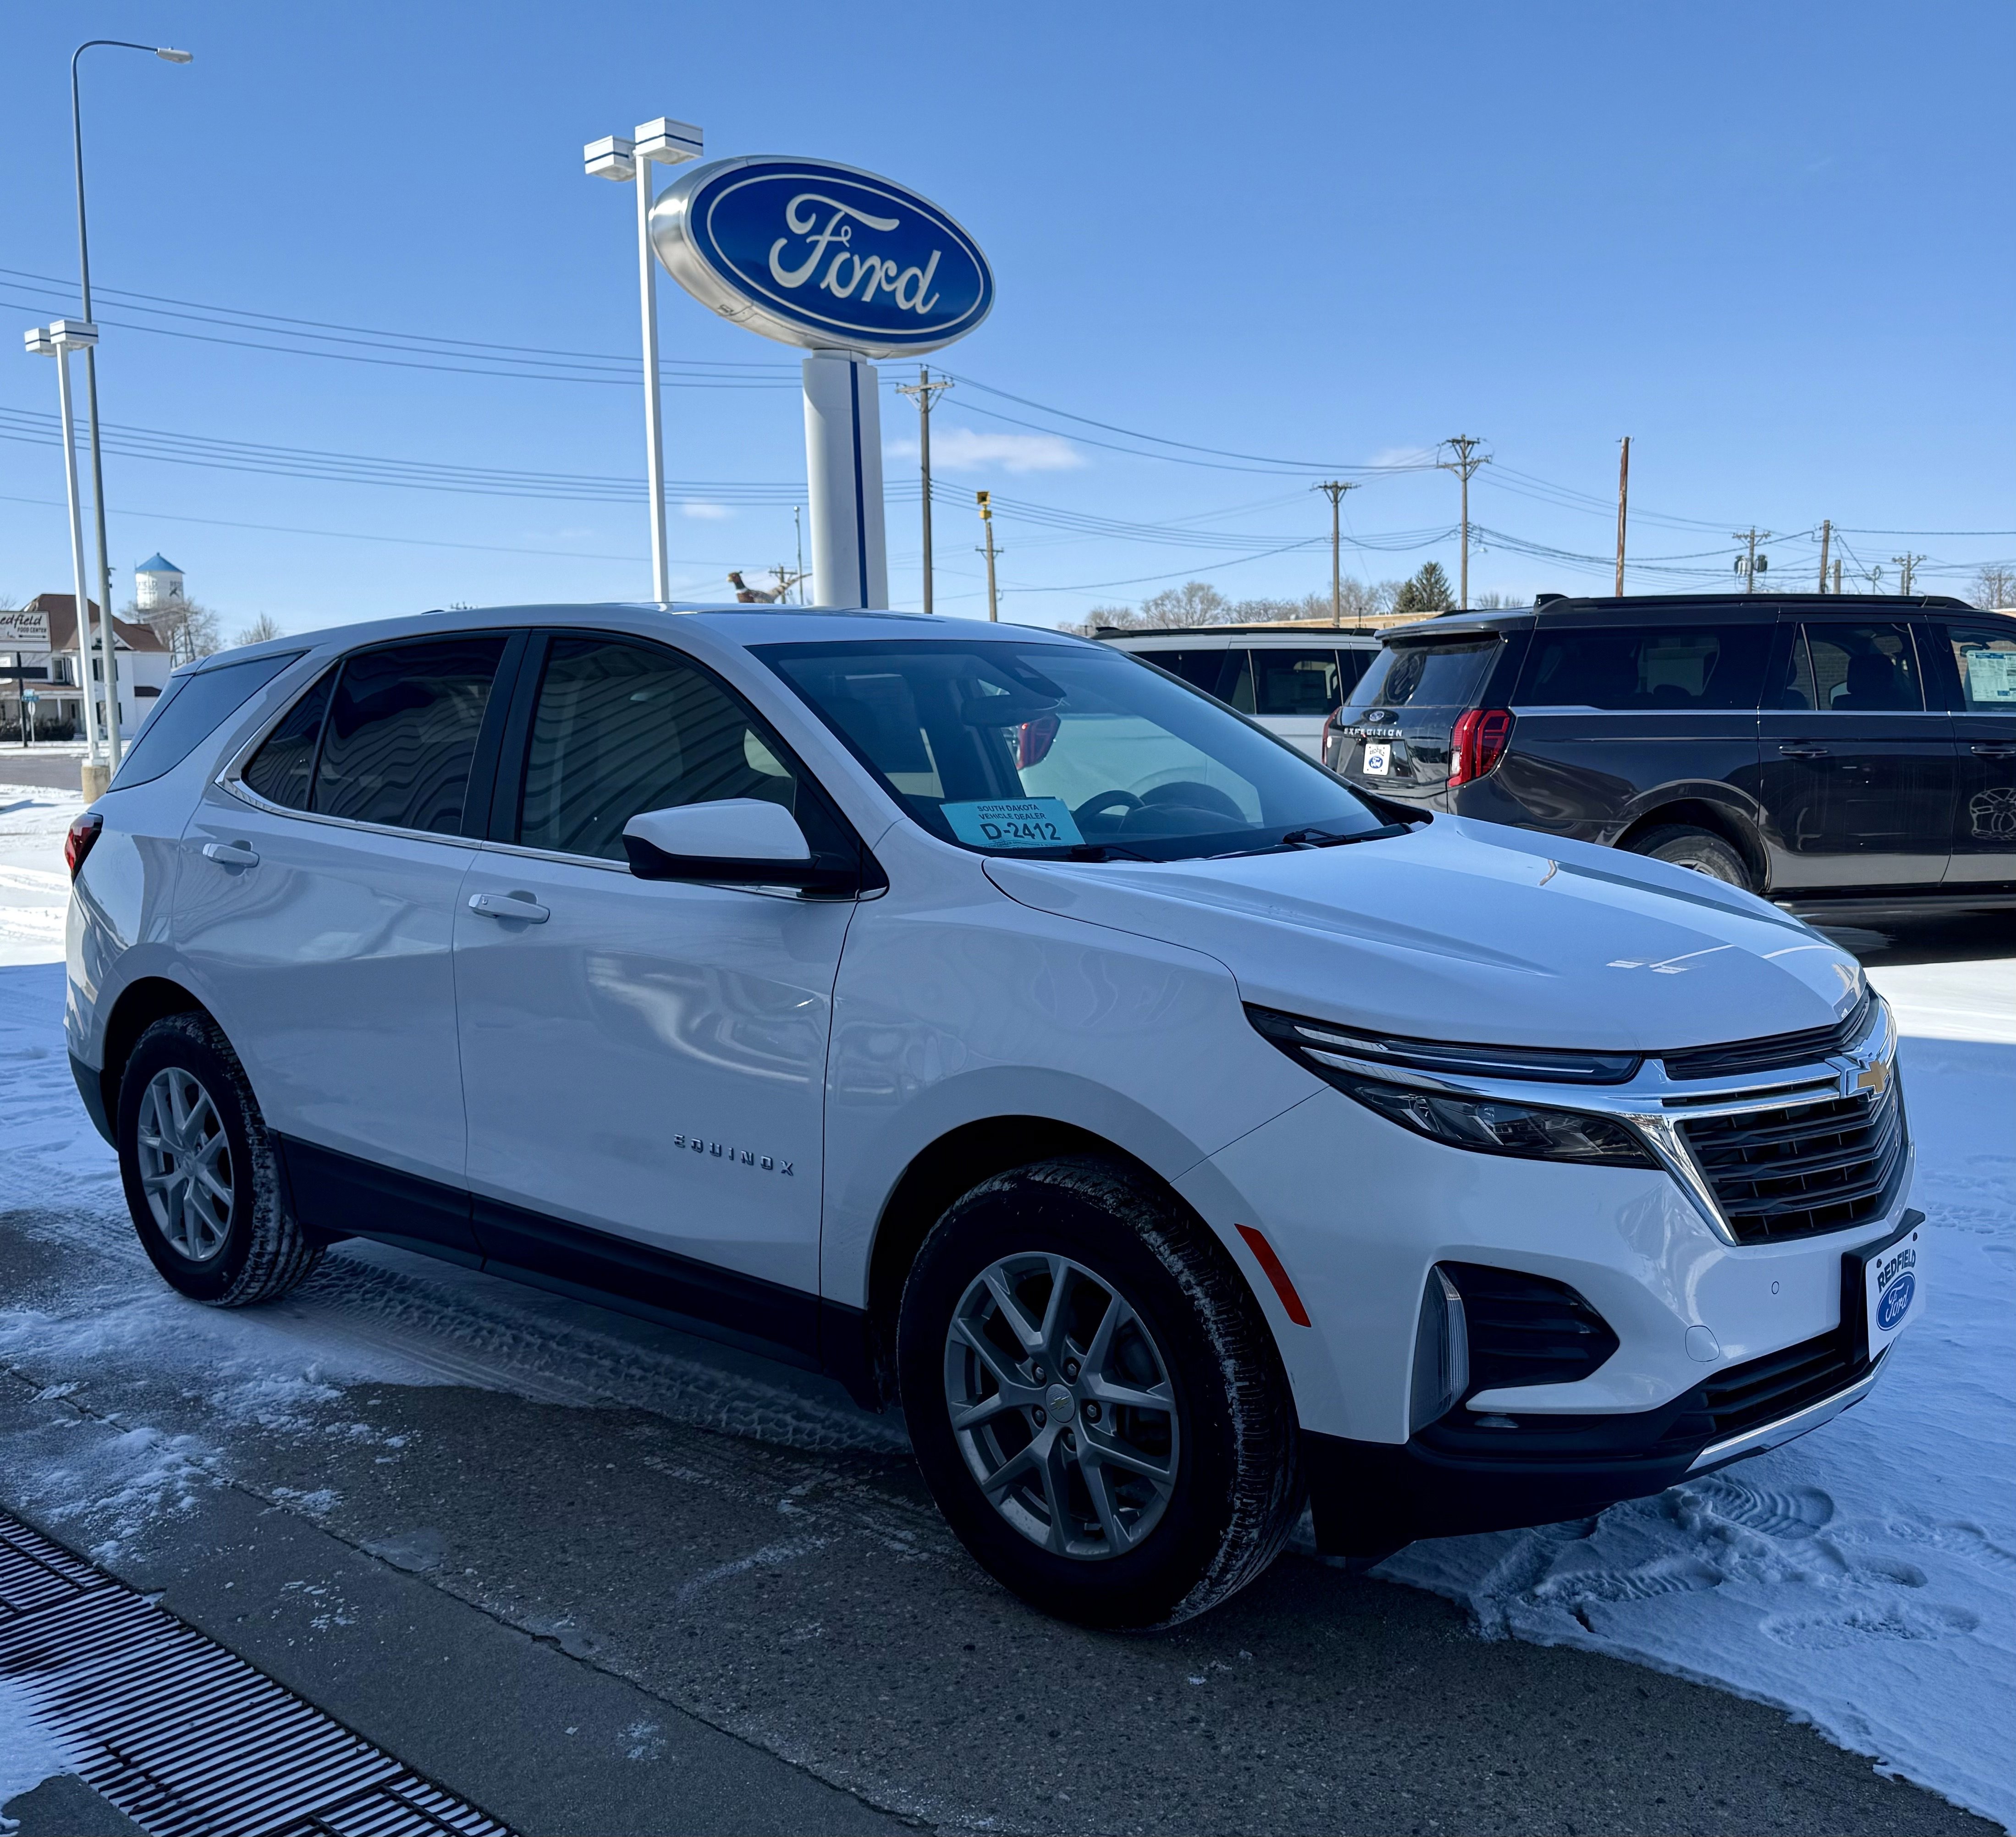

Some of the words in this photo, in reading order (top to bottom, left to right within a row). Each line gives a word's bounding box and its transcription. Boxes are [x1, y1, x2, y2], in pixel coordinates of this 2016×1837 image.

[768, 193, 942, 314] Ford
[1344, 727, 1403, 737] EXPEDITION
[980, 822, 1062, 840] D-2412
[673, 1133, 794, 1176] EQUINOX
[1877, 1248, 1916, 1294] REDFIELD
[1885, 1282, 1910, 1322] Ford
